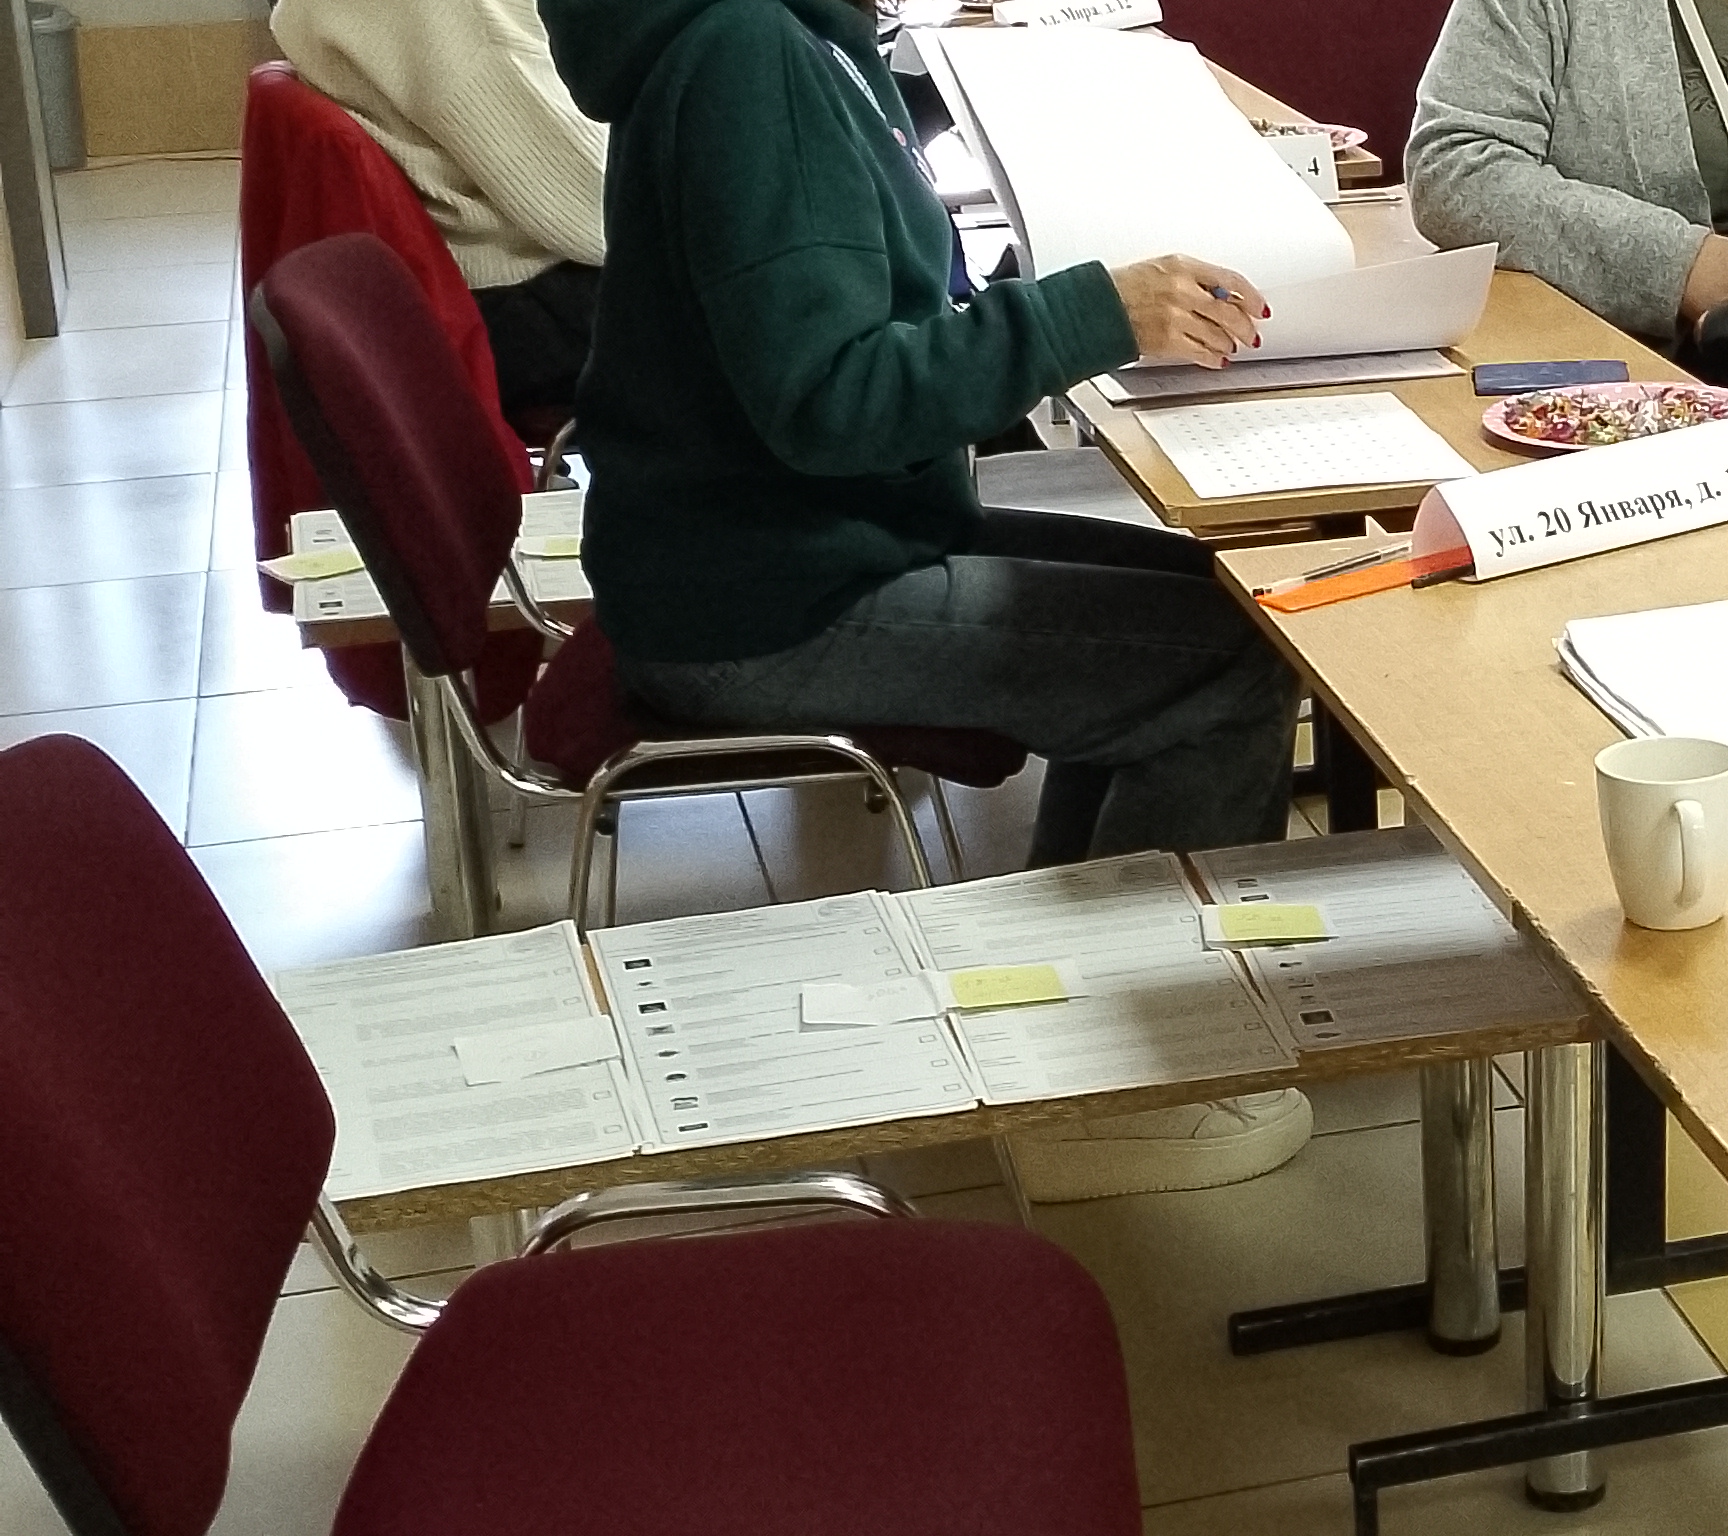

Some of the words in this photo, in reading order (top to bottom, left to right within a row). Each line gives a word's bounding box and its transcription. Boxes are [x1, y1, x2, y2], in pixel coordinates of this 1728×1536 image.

[1488, 523, 1536, 557] ул.
[1537, 507, 1572, 537] 20
[1577, 486, 1693, 529] Января,
[1697, 480, 1722, 505] д.
